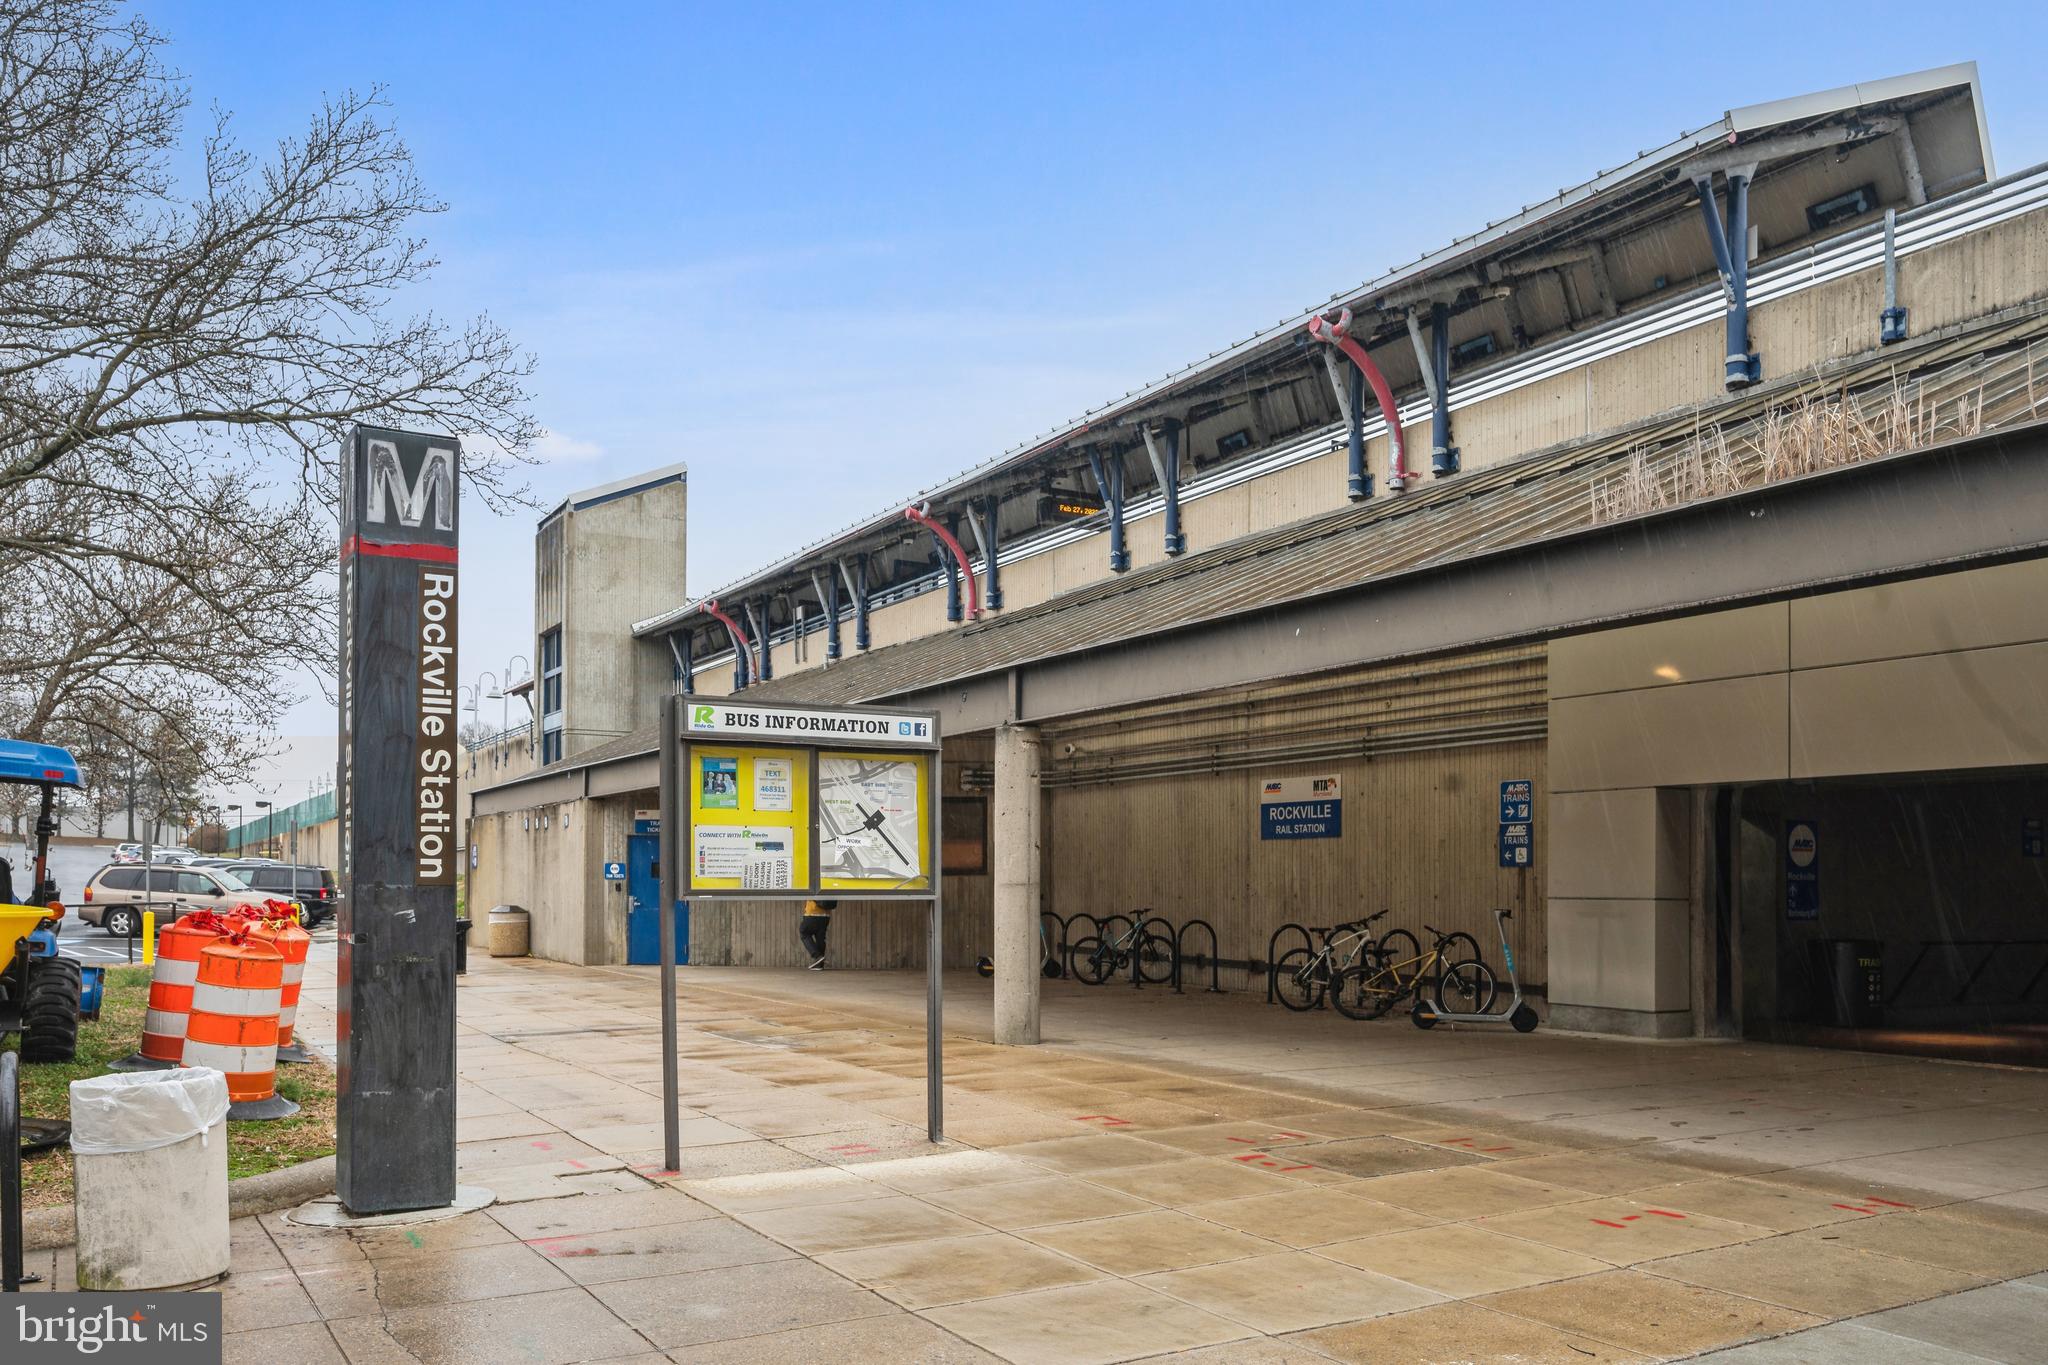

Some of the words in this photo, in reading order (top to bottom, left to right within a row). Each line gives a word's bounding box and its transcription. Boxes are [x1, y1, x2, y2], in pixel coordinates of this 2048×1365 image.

[366, 438, 454, 532] M
[1059, 504, 1072, 513] Feb
[345, 564, 353, 730] Rockville
[421, 572, 454, 738] Rockville
[724, 712, 760, 728] BUS
[765, 714, 890, 735] INFORMATION
[764, 769, 782, 777] TEXT
[760, 785, 786, 793] 468311
[1312, 779, 1328, 791] MTA
[1507, 783, 1529, 793] MARC
[1503, 793, 1530, 803] TRAINS
[344, 743, 352, 873] Station
[419, 748, 453, 879] Station
[1269, 804, 1332, 821] ROCKVILLE
[1275, 825, 1293, 834] RAIL
[1294, 823, 1326, 834] STATION
[1507, 825, 1527, 833] MARC
[1503, 836, 1529, 845] TRAINS
